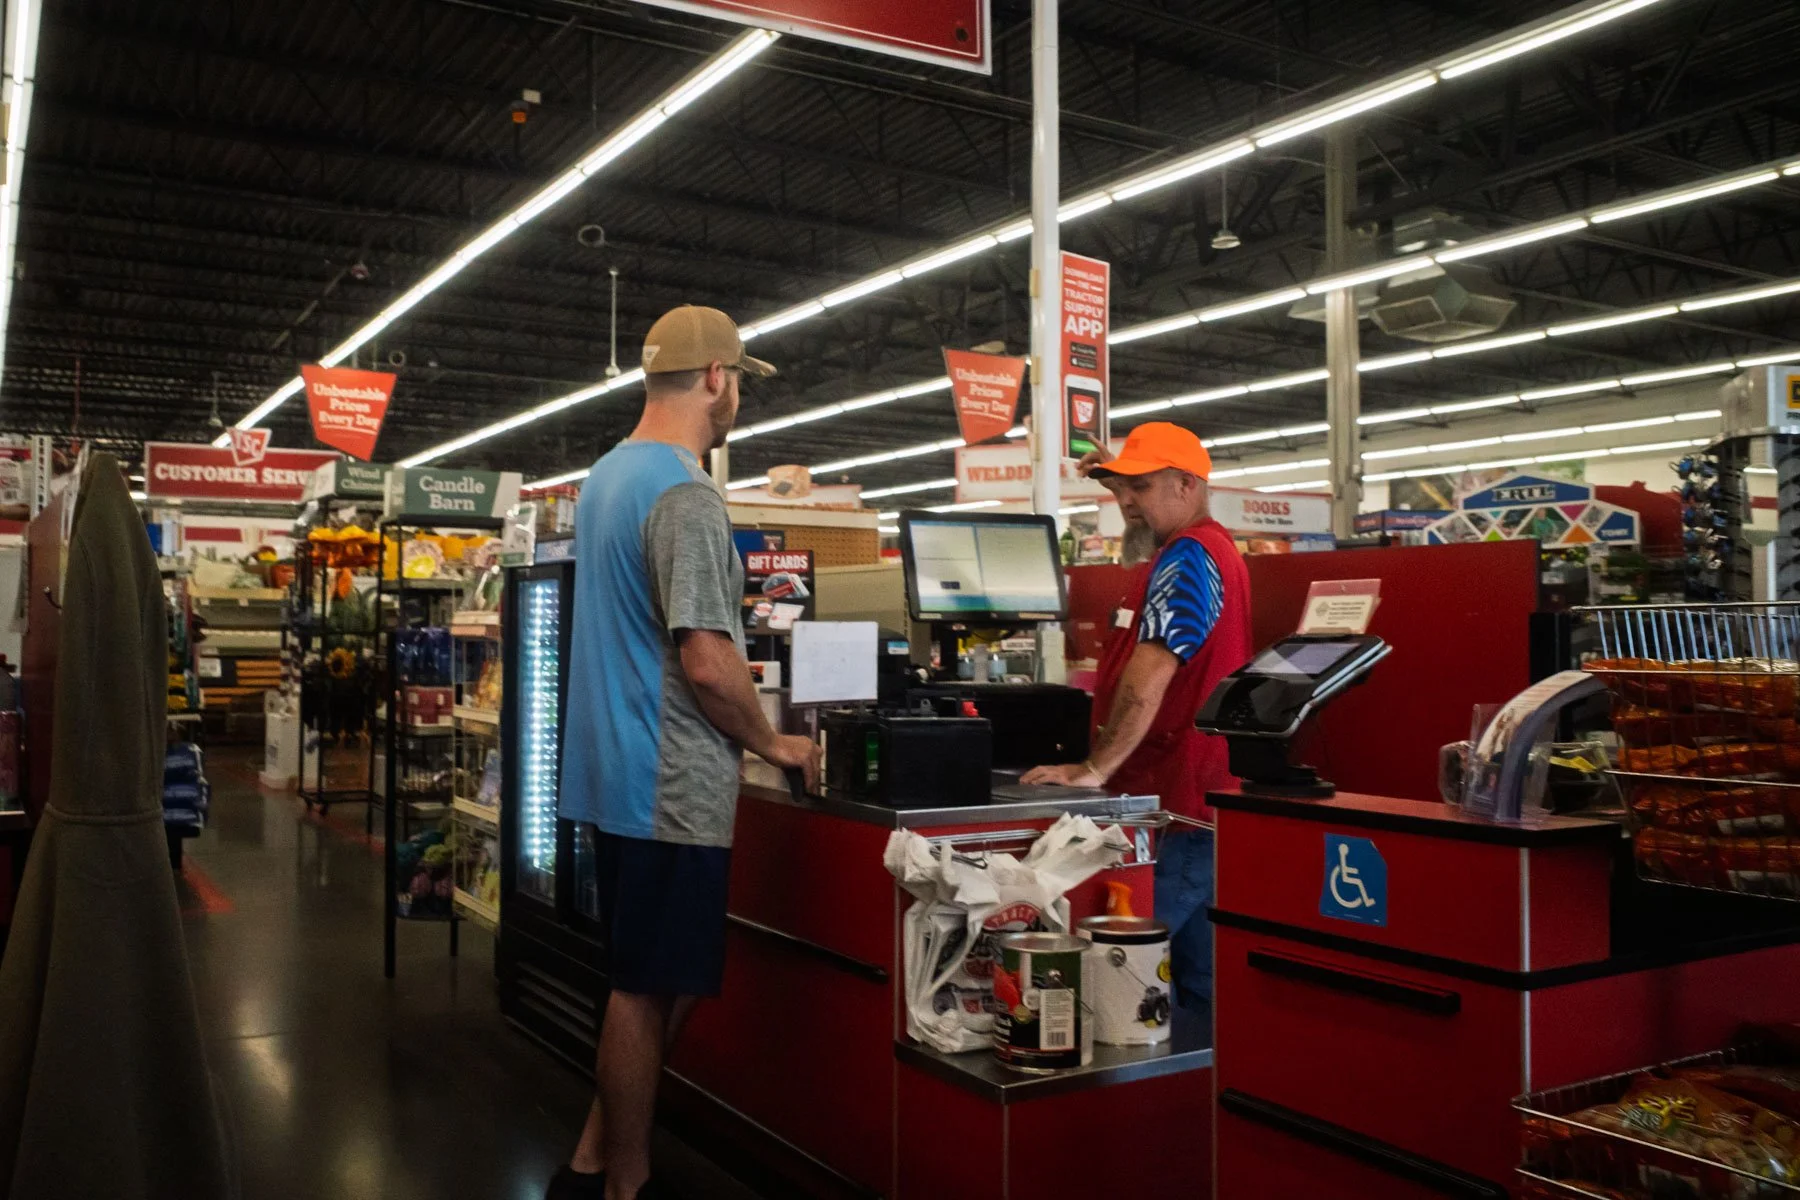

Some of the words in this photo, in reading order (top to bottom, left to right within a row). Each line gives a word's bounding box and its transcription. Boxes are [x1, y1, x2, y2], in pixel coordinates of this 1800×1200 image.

[1064, 287, 1104, 305] TRACTOR
[1064, 300, 1104, 319] SUPPLY
[1064, 314, 1104, 339] APP
[313, 382, 388, 402] Unbeatable
[969, 382, 1004, 399] Prices
[329, 397, 371, 413] Prices
[960, 396, 990, 414] Every
[991, 400, 1011, 416] Day
[318, 410, 355, 427] Every
[355, 413, 381, 430] Day
[154, 462, 257, 484] CUSTOMER
[262, 467, 310, 486] SERV
[347, 467, 381, 480] Wind
[966, 465, 1033, 483] WELDIN
[419, 475, 486, 495] Candle
[428, 493, 476, 512] Barn
[1242, 499, 1292, 516] BOOKS
[748, 554, 773, 570] GIFT
[773, 555, 809, 571] CARDS
